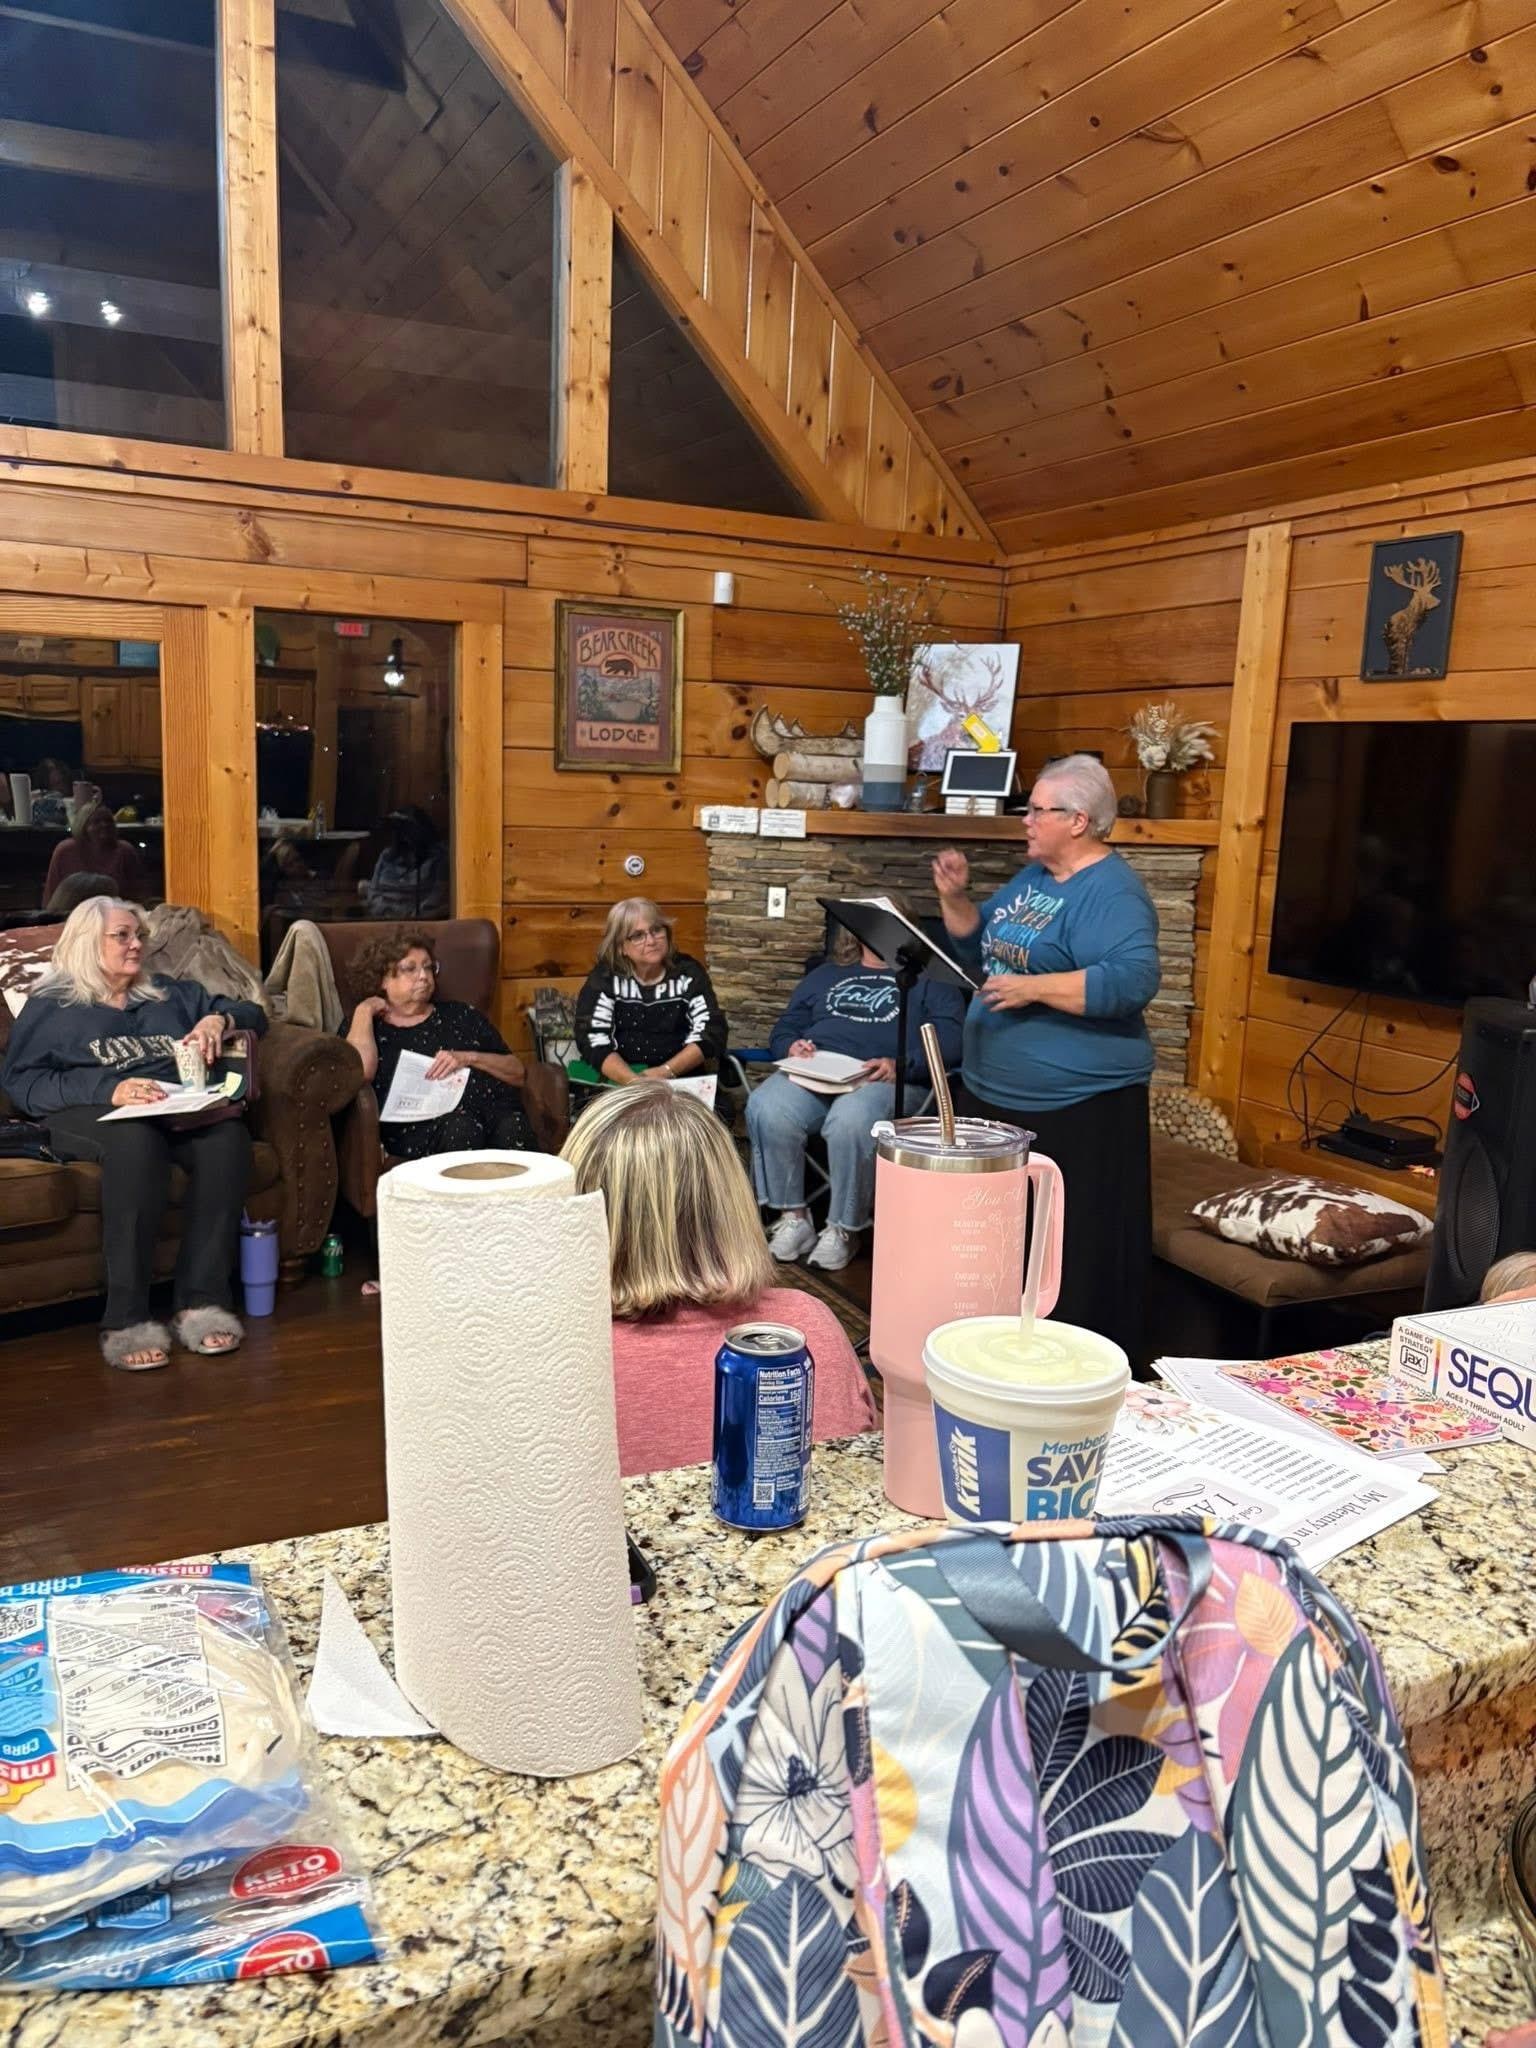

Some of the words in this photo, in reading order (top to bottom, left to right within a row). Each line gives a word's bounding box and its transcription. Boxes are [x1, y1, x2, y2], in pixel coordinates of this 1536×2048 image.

[580, 631, 618, 663] BEAR
[618, 631, 658, 669] CREEK
[589, 725, 648, 743] LODGE
[834, 985, 901, 1013] Faith
[1399, 1336, 1433, 1354] STRATEGY
[1405, 1328, 1424, 1341] GAME
[1425, 1335, 1433, 1344] OF
[1403, 1349, 1422, 1368] jax
[760, 1370, 787, 1378] Nutrition
[1447, 1348, 1536, 1423] SEQU
[1446, 1391, 1464, 1403] AGES
[1469, 1400, 1502, 1421] THROUGH
[1503, 1417, 1527, 1432] ADULT
[951, 1425, 981, 1517] KWIK
[1026, 1477, 1100, 1520] BIG
[1214, 1493, 1238, 1506] I
[1353, 1490, 1388, 1504] My
[1239, 1506, 1263, 1520] God
[1305, 1502, 1367, 1530] Identity
[1293, 1528, 1318, 1538] in
[20, 1576, 82, 1594] CARB
[194, 1696, 216, 1710] Total
[142, 1719, 219, 1737] Calories
[2, 1737, 39, 1756] CARB
[243, 1854, 327, 1888] KETO
[256, 1950, 315, 1976] ETO
